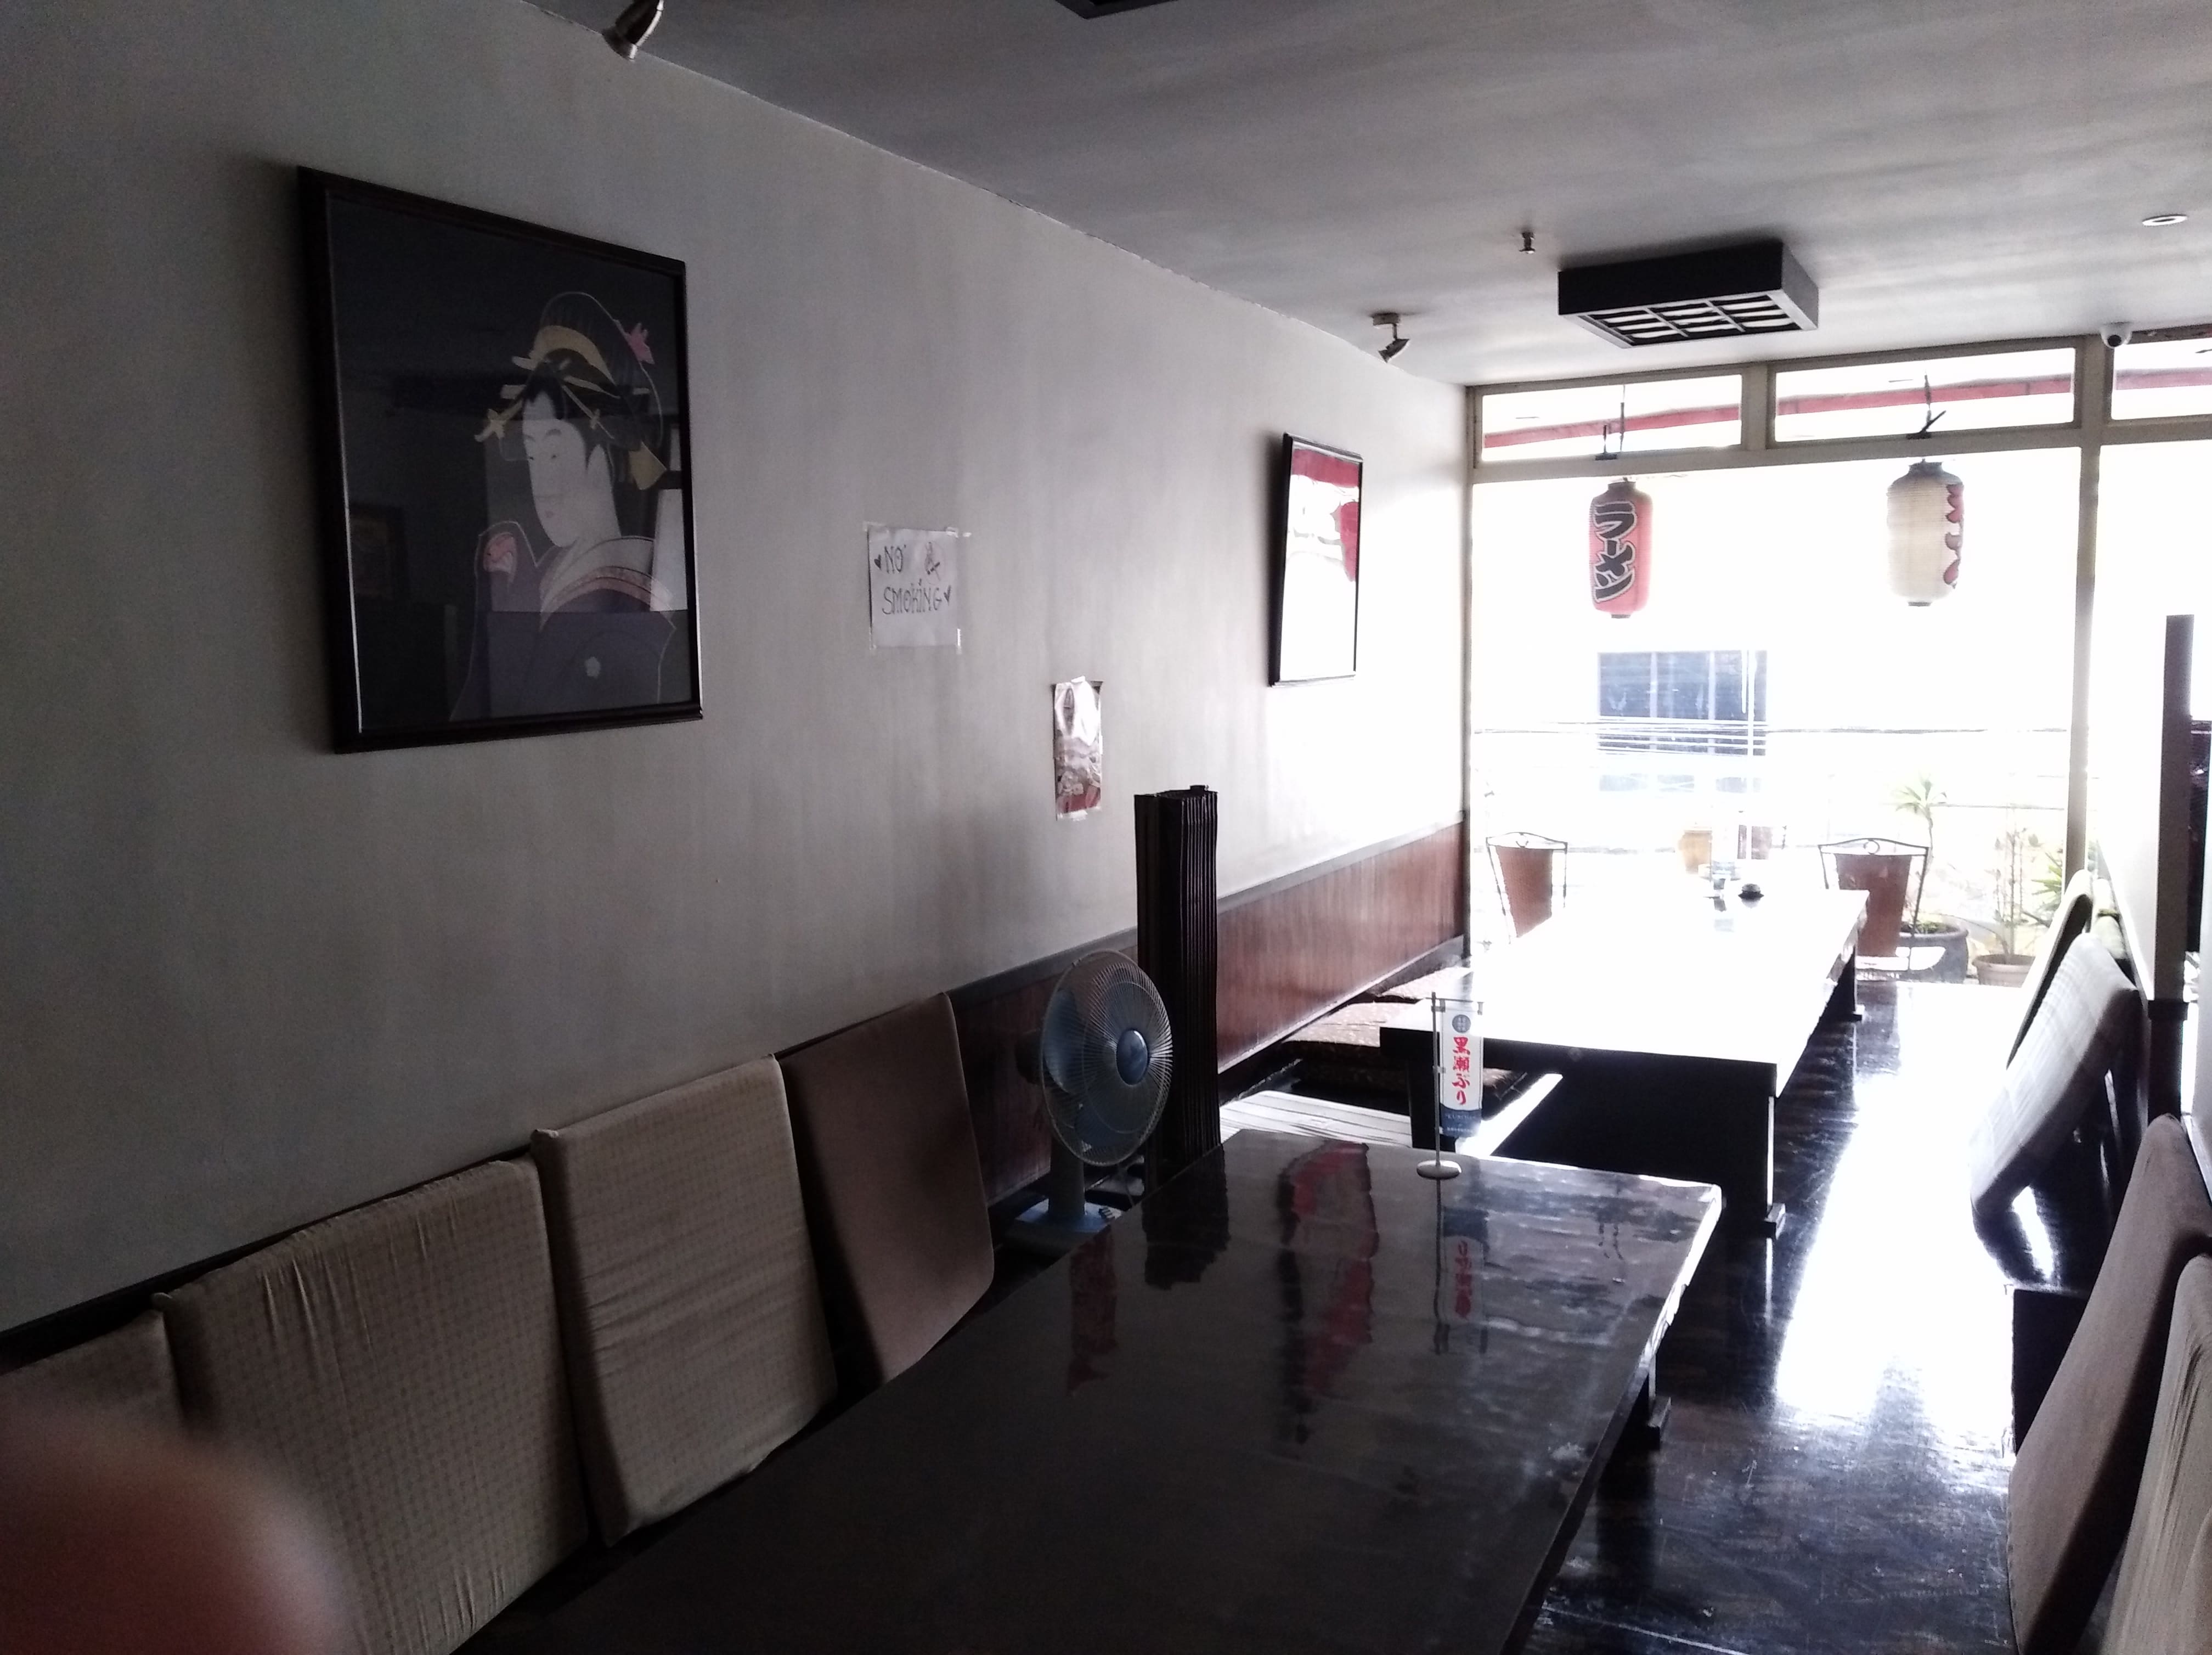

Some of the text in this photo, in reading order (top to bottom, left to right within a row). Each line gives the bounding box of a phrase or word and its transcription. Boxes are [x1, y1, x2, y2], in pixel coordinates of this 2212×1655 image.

[884, 545, 904, 573] NO
[1593, 500, 1637, 603] ラーメン
[882, 584, 942, 615] SMOKING
